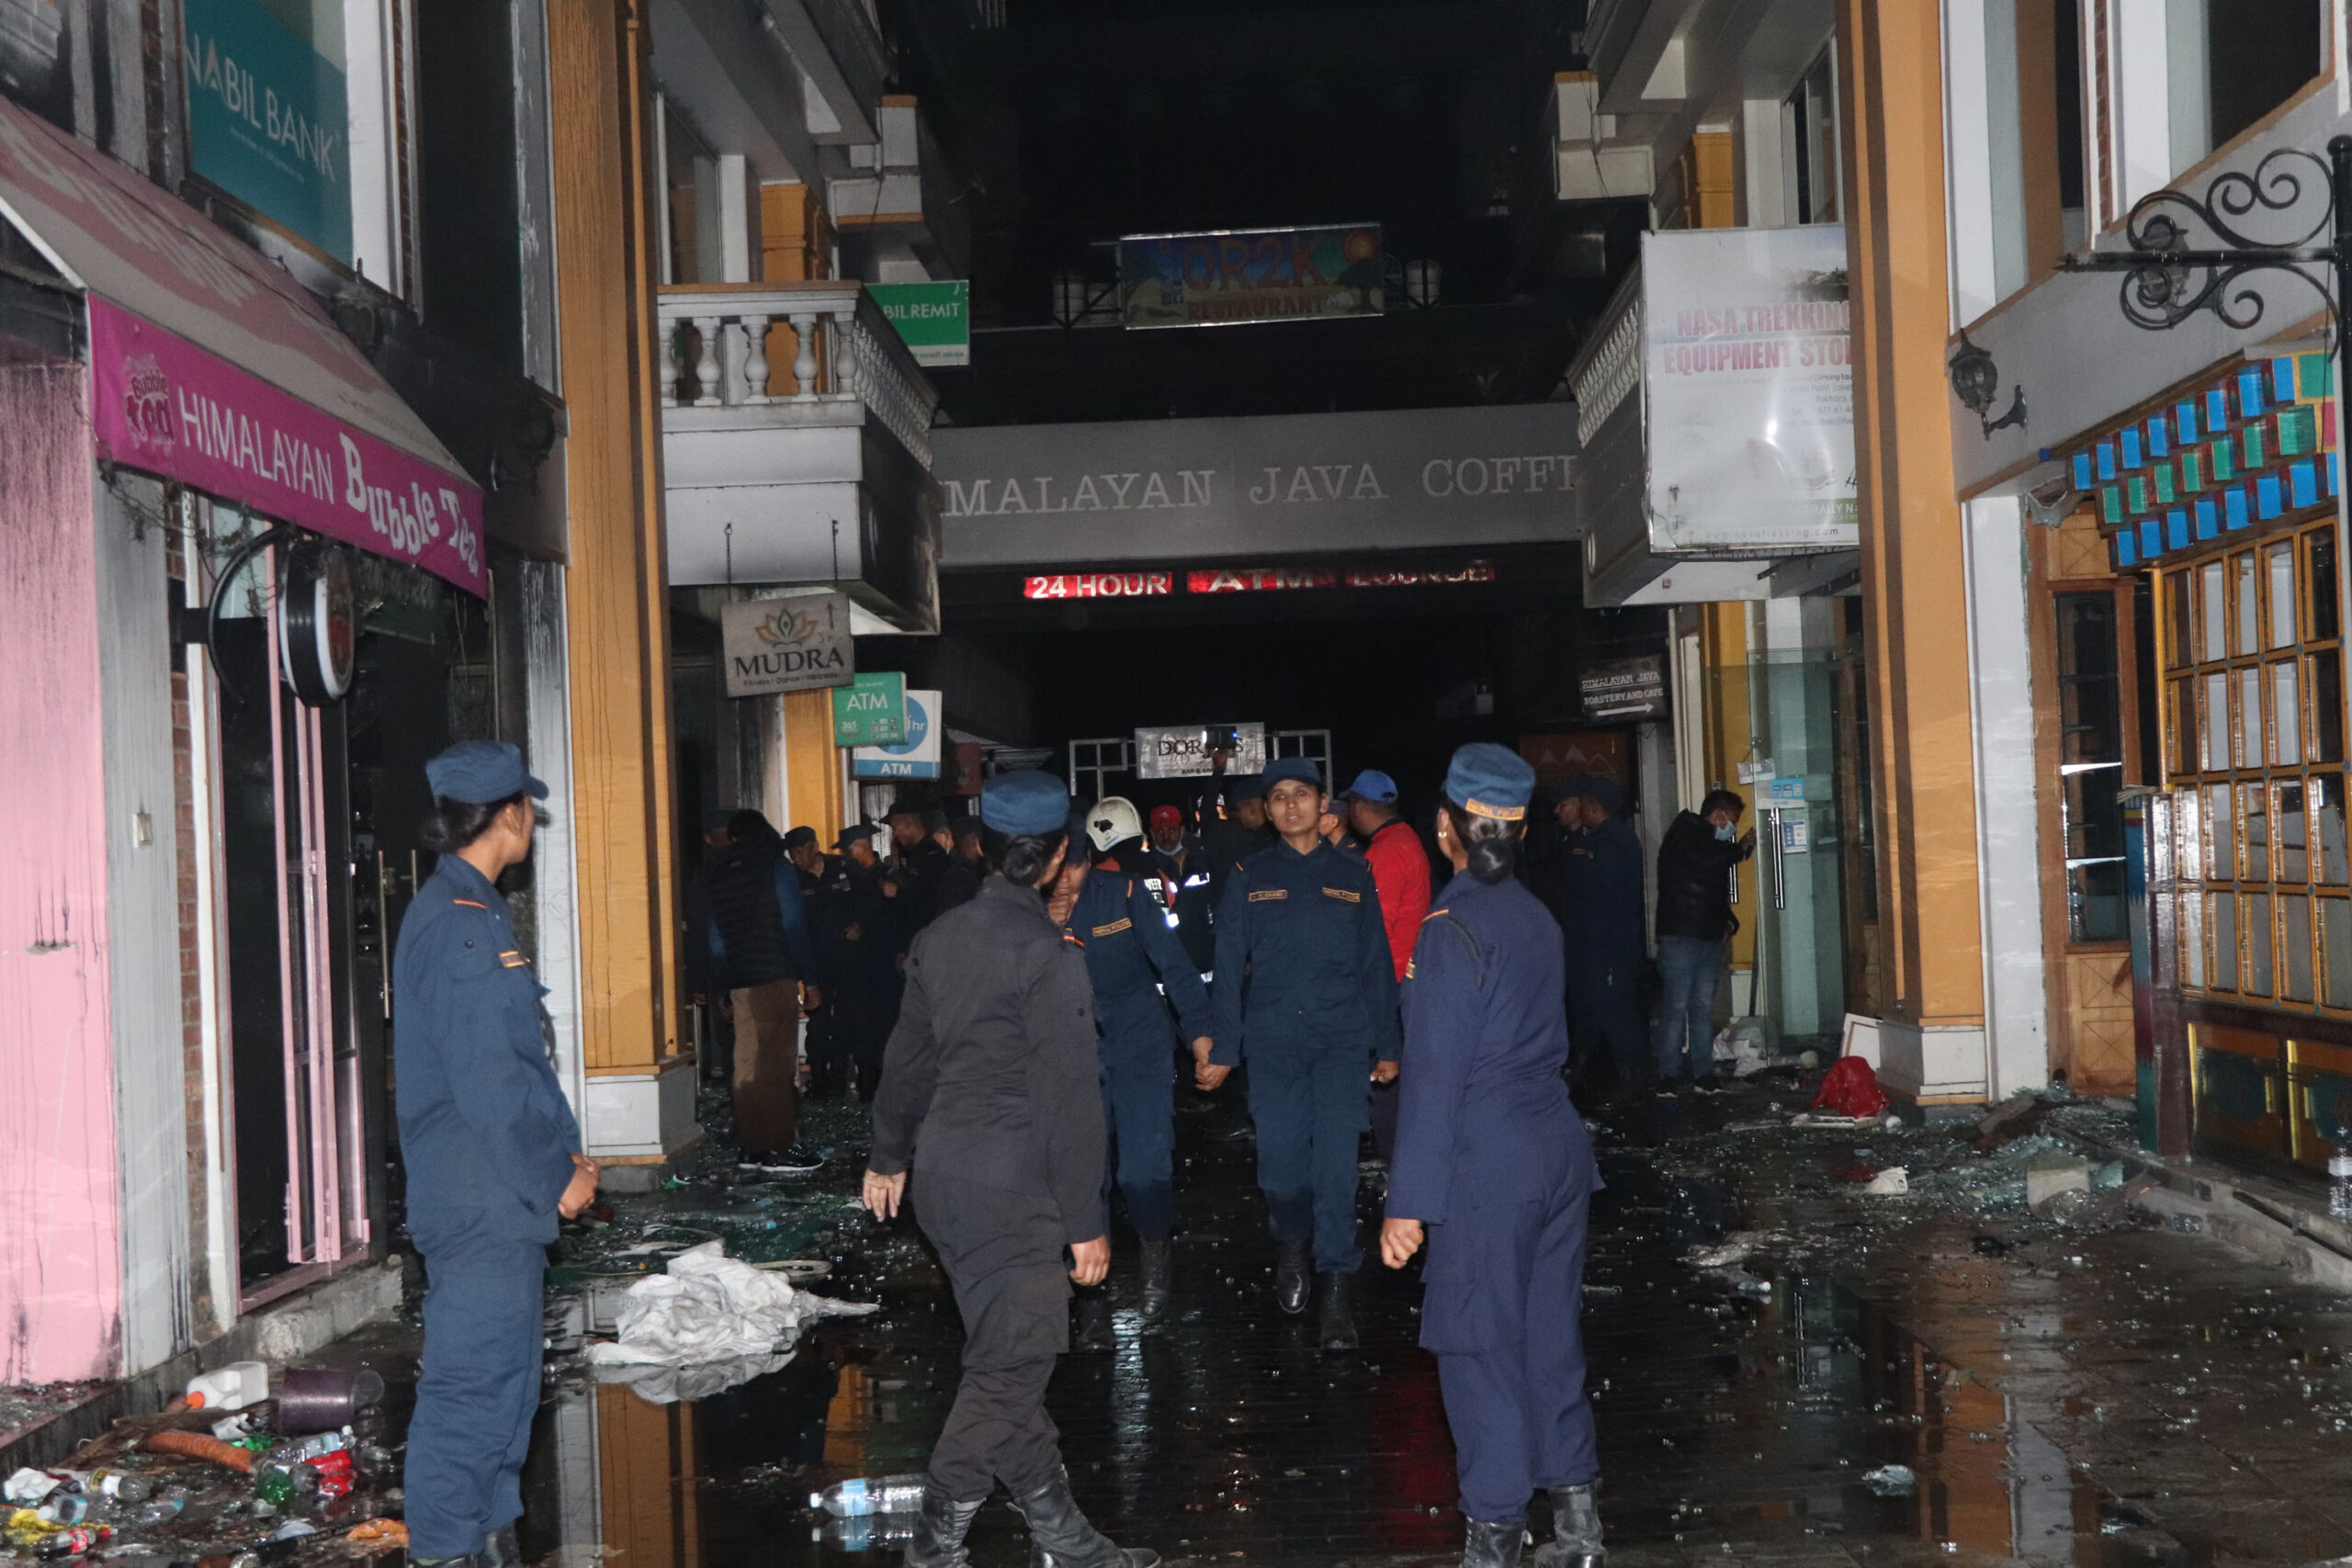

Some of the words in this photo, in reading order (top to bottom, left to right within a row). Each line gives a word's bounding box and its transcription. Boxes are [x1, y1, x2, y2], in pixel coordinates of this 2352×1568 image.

[185, 33, 262, 130] NABIL
[266, 85, 336, 183] BANK
[1677, 307, 1739, 336] NASA
[1663, 340, 1792, 376] EQUIPMENT
[178, 386, 334, 504] HIMALAYAN
[339, 432, 440, 555] Bubble
[438, 488, 479, 578] Tea
[939, 469, 1215, 516] MALAYAN
[1250, 463, 1389, 504] JAVA
[1032, 577, 1067, 598] 24
[1077, 574, 1168, 597] HOUR
[1208, 568, 1314, 592] ATM
[734, 647, 844, 677] MUDRA
[1637, 671, 1660, 683] JAVA
[846, 693, 888, 712] ATM
[1584, 693, 1625, 705] ROASTERY
[1627, 691, 1643, 700] AND
[880, 762, 912, 775] ATM
